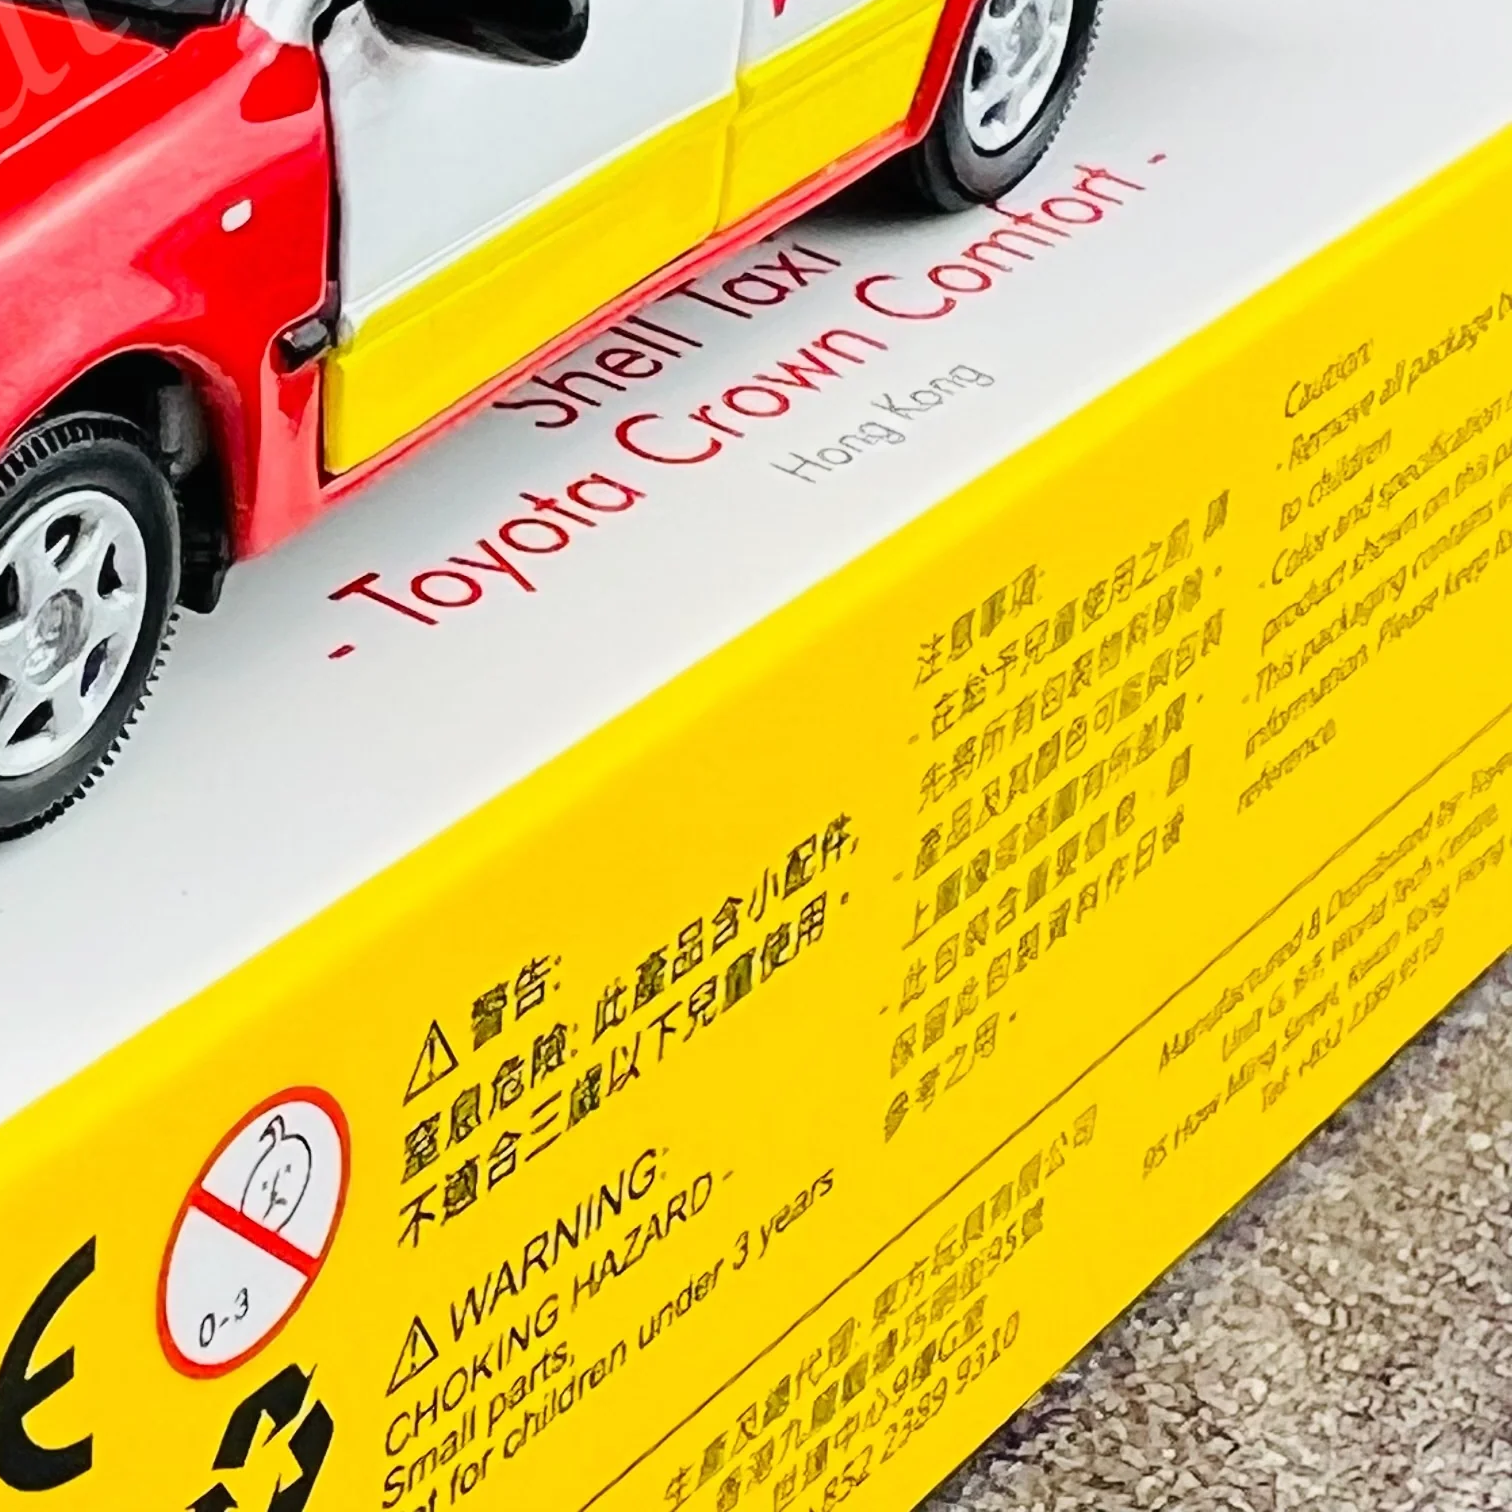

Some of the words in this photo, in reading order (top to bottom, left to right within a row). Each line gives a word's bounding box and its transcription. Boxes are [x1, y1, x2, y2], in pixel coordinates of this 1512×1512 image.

[329, 471, 646, 626] Toyota
[615, 325, 888, 466] Crown
[854, 164, 1146, 320] Comfort
[491, 313, 703, 429] Shell
[656, 242, 842, 319] Taxi
[769, 418, 888, 485] Hong
[888, 363, 996, 428] Kong
[197, 1287, 251, 1349] 0-3
[383, 1291, 560, 1458] CHOKING
[569, 1169, 713, 1315] HAZARD
[448, 1145, 670, 1343] WARNING:
[448, 1444, 496, 1505] for
[501, 1338, 628, 1460] children
[636, 1256, 725, 1351] under
[731, 1228, 750, 1271] 3
[756, 1166, 835, 1260] years
[378, 1403, 477, 1512] Small
[485, 1339, 576, 1439] parts,
